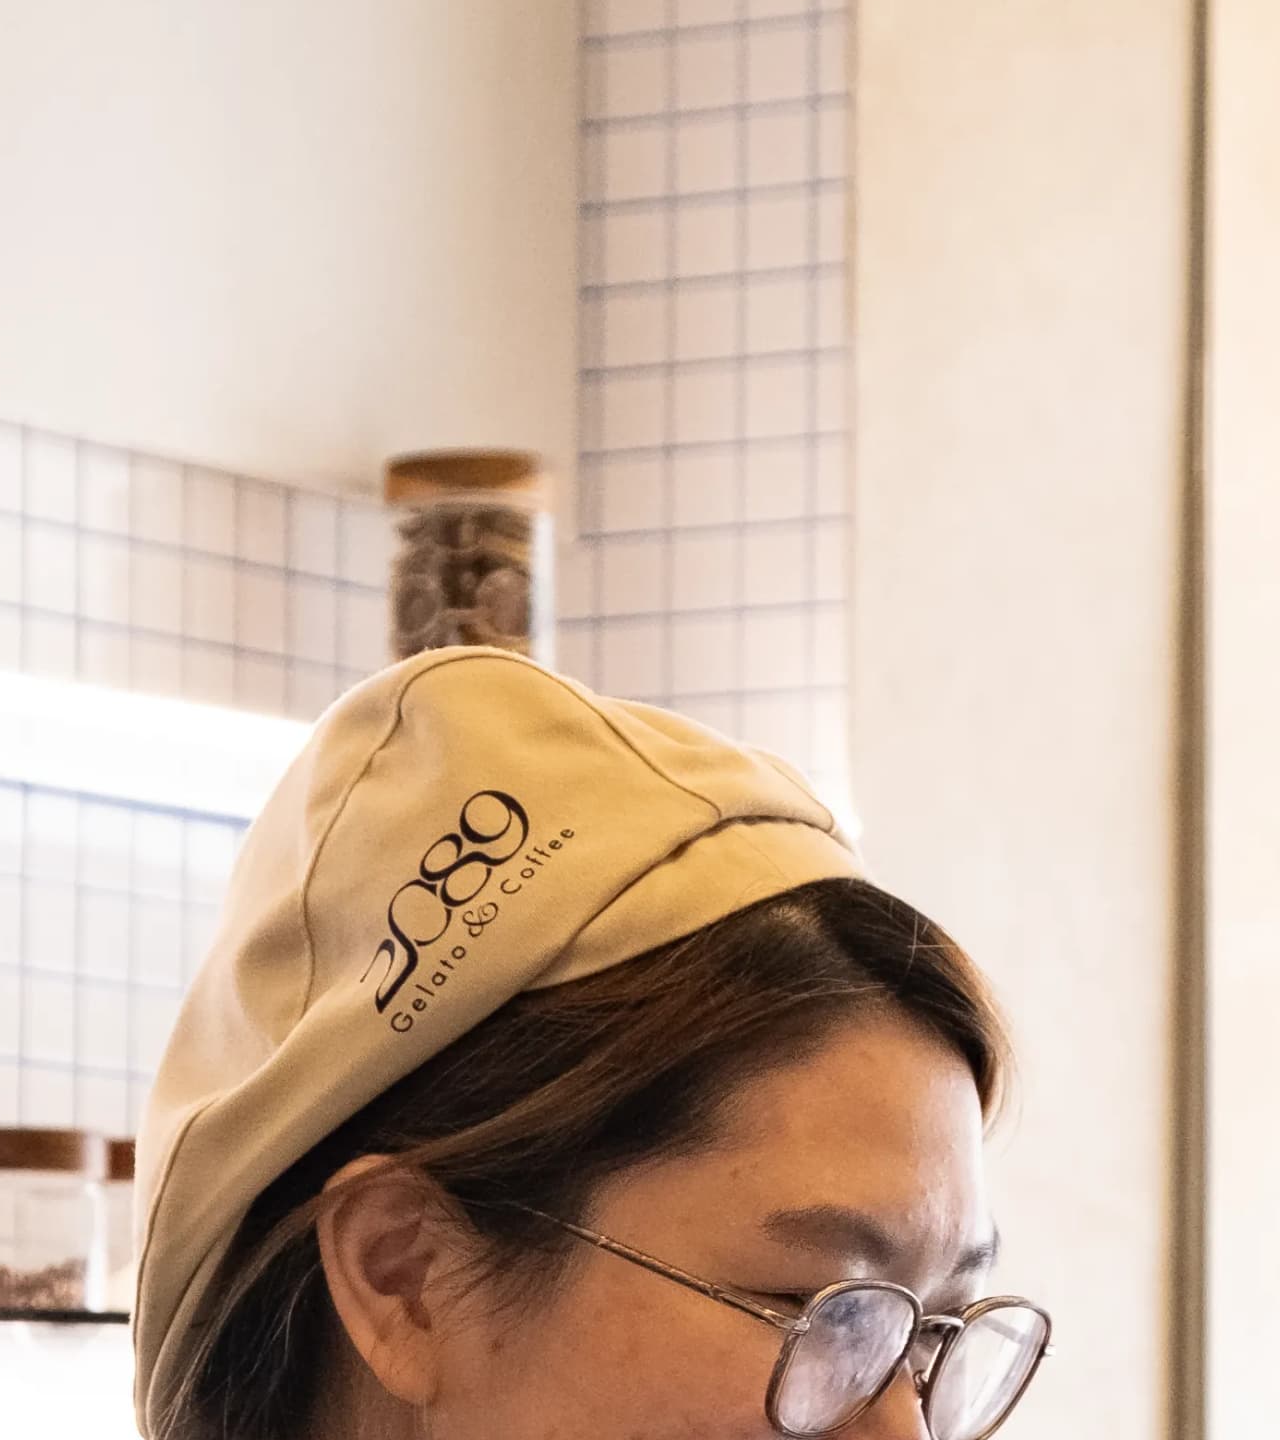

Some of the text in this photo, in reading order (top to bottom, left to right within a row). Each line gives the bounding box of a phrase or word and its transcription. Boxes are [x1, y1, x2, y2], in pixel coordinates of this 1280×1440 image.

[360, 790, 529, 1013] 2089
[391, 828, 575, 1032] Gelato & Coffee
